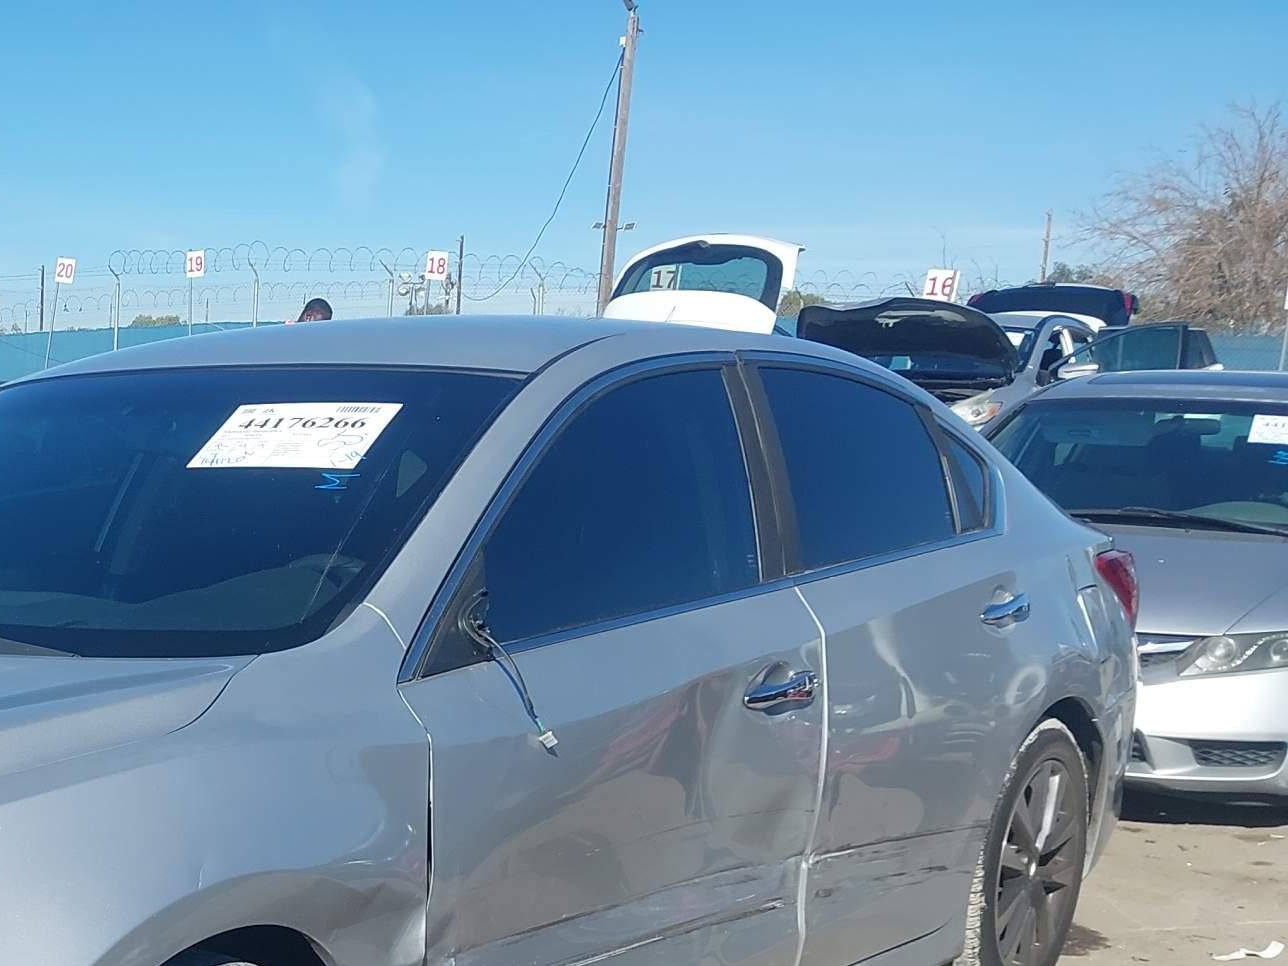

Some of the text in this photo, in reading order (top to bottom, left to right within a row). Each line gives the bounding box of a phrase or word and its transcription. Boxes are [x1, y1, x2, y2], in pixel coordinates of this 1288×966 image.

[57, 262, 74, 280] 20
[188, 255, 204, 274] 19
[427, 256, 447, 275] 18
[652, 269, 676, 289] 17
[239, 416, 367, 429] 44176266
